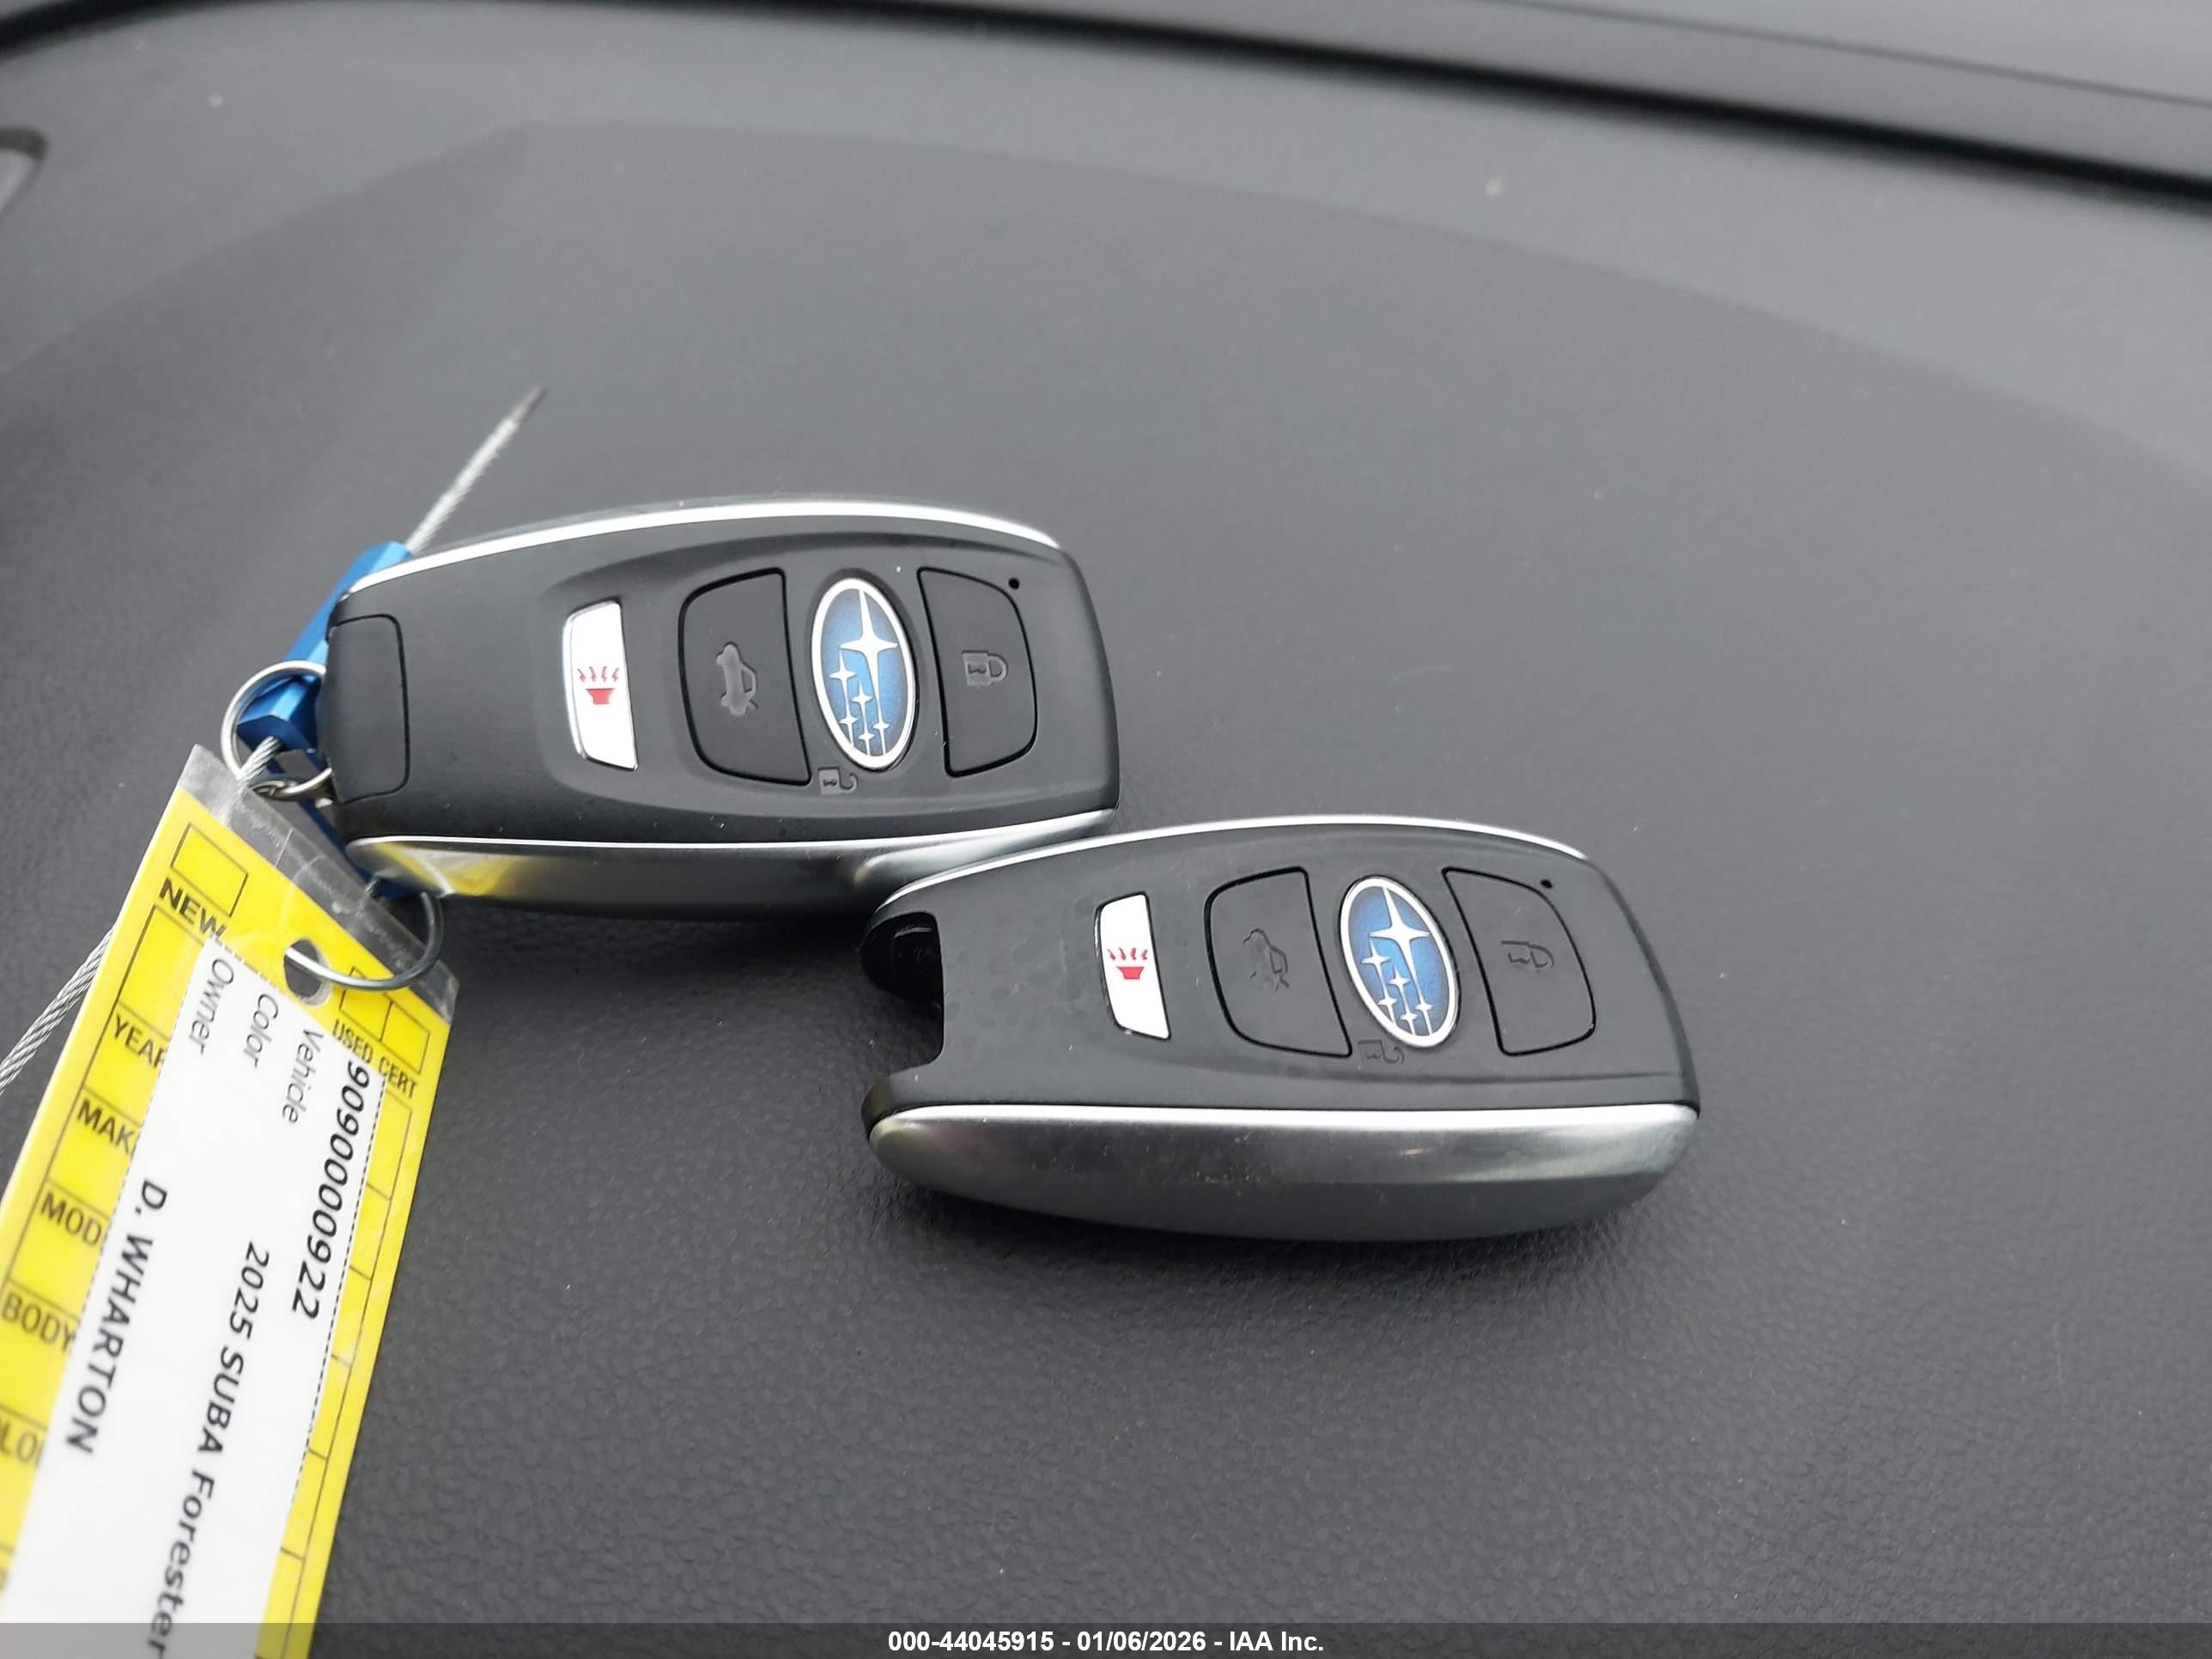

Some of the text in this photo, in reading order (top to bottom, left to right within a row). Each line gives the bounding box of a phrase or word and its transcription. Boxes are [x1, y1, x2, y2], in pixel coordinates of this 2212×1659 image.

[158, 878, 227, 940] NEW
[188, 957, 234, 1055] Owner
[242, 992, 280, 1069] Color
[282, 1028, 324, 1123] Vehicle
[332, 1019, 418, 1099] USED CERT
[292, 1060, 370, 1320] 9090000922
[3, 1292, 76, 1353] BODY
[65, 1180, 167, 1455] D. WHARTON
[147, 1242, 270, 1659] 2025 SUBA Forester
